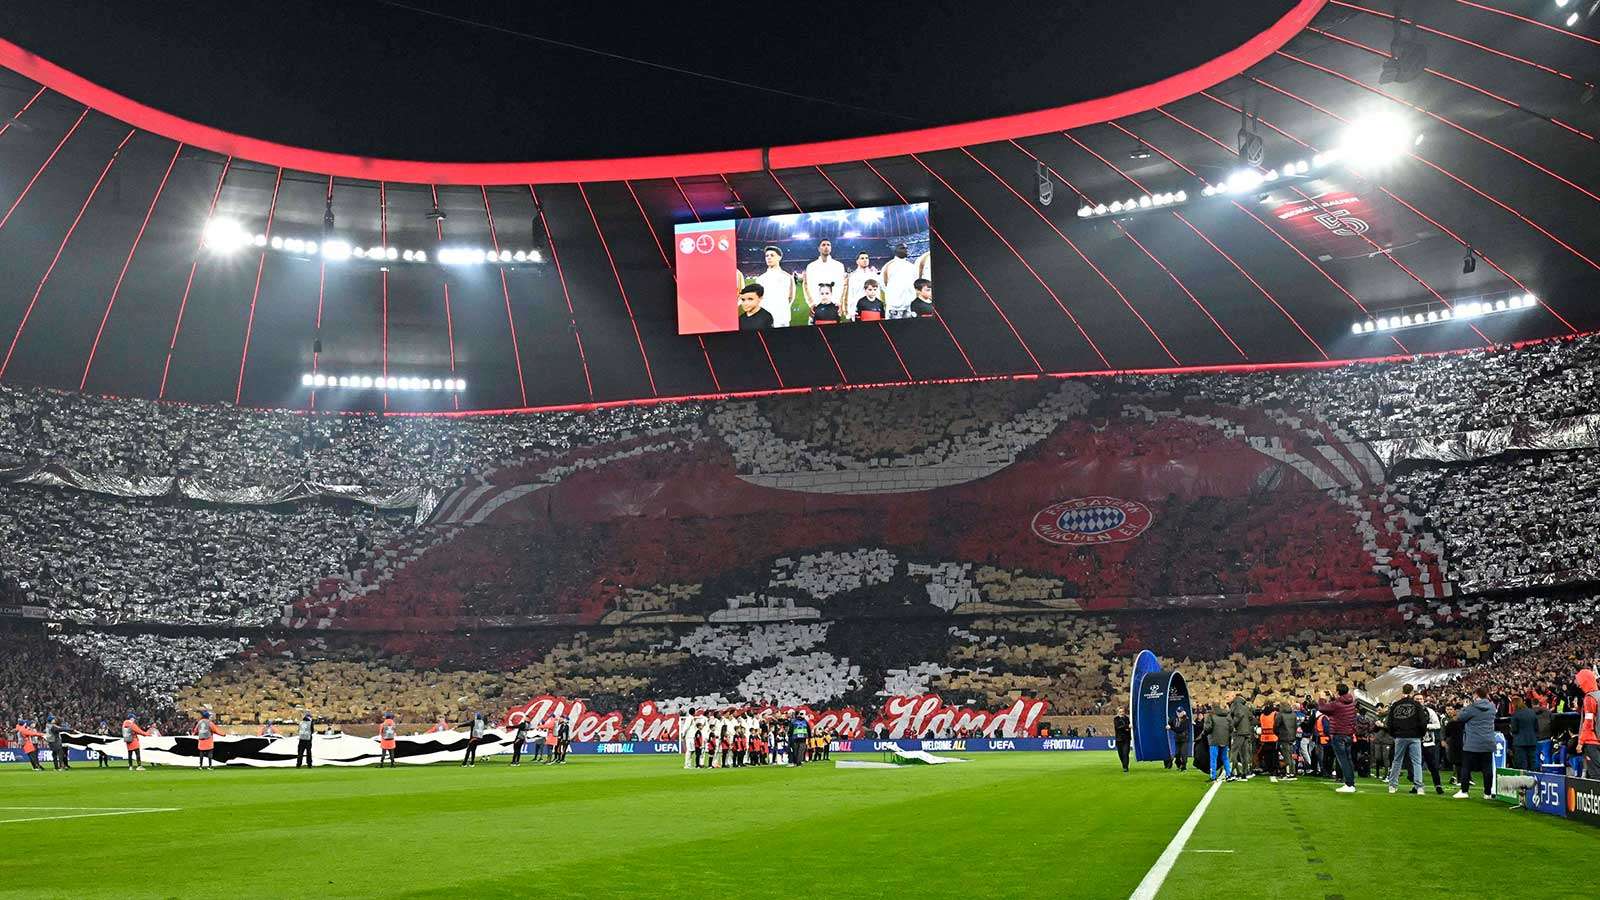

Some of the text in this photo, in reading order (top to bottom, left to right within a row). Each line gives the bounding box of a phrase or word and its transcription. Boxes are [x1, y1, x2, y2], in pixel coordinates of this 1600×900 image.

[1313, 209, 1369, 236] 5
[508, 699, 620, 742] Alles
[629, 704, 677, 741] in
[873, 698, 1043, 739] Hand!
[597, 743, 634, 752] #FOOTBALL
[654, 744, 678, 752] UEFA
[921, 740, 966, 750] WELCOME ALL
[989, 740, 1015, 749] UEFA
[1042, 739, 1084, 749] #FOOTBALL
[0, 751, 15, 761] EFA
[1540, 781, 1559, 806] PS5
